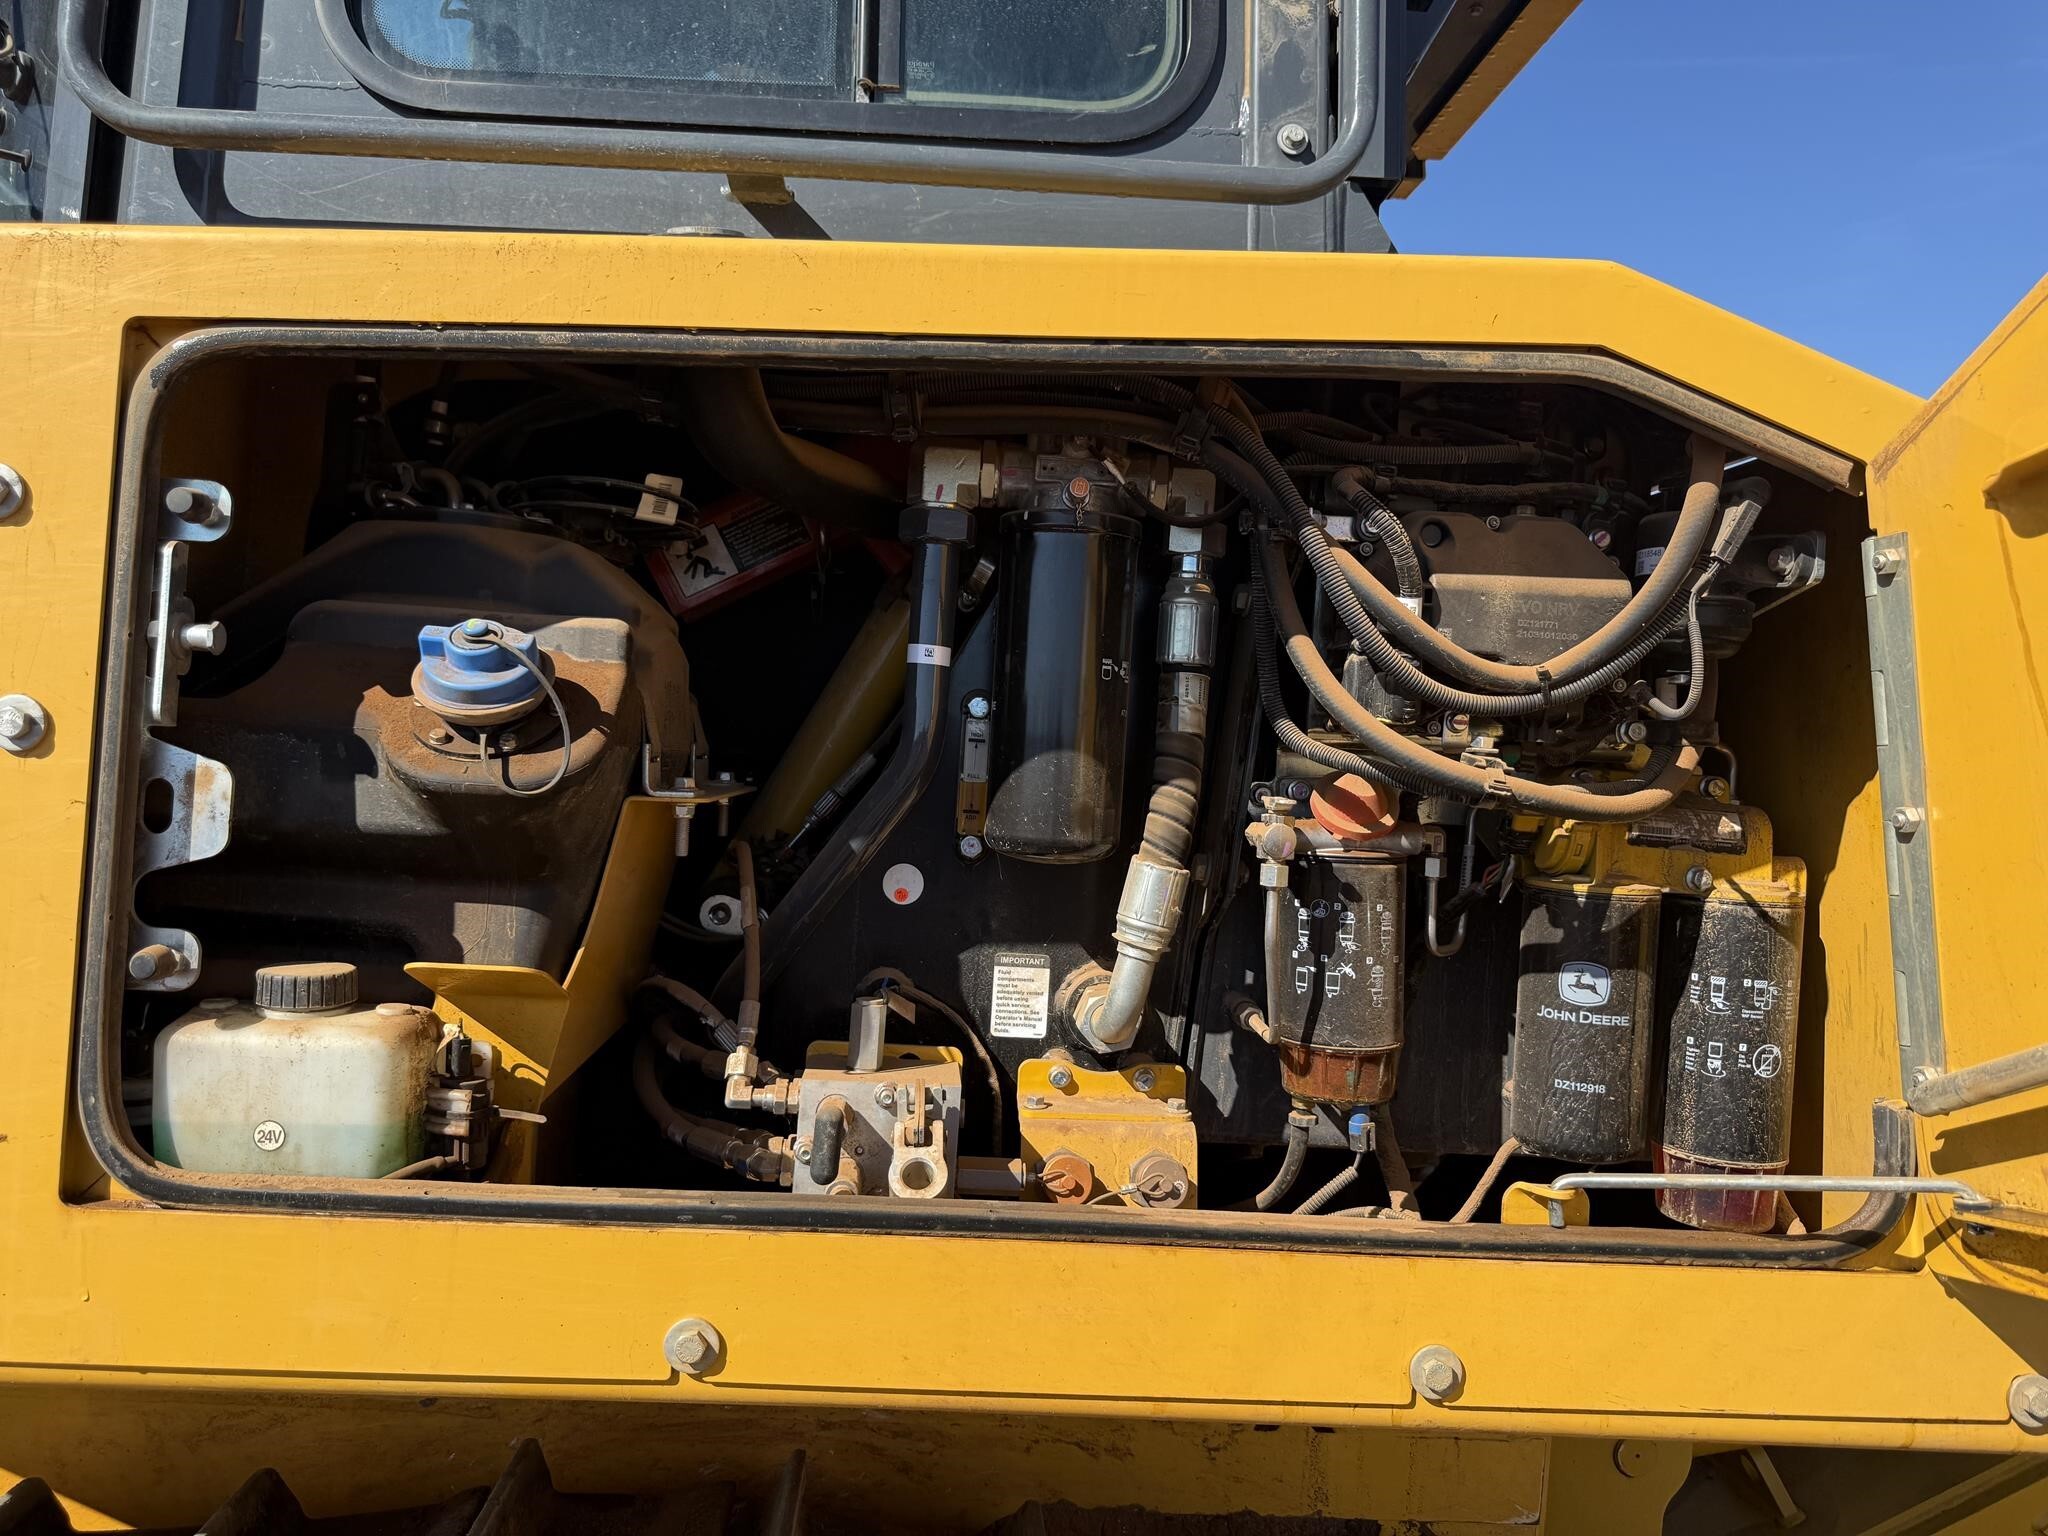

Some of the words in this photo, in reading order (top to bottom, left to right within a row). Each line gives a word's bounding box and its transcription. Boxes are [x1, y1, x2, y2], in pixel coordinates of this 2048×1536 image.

[1000, 956, 1045, 965] IMPORTANT
[1537, 1005, 1576, 1022] JOHN
[1579, 1011, 1630, 1026] DEERE
[1554, 1079, 1606, 1093] DZ112918
[257, 1130, 282, 1144] 24V
